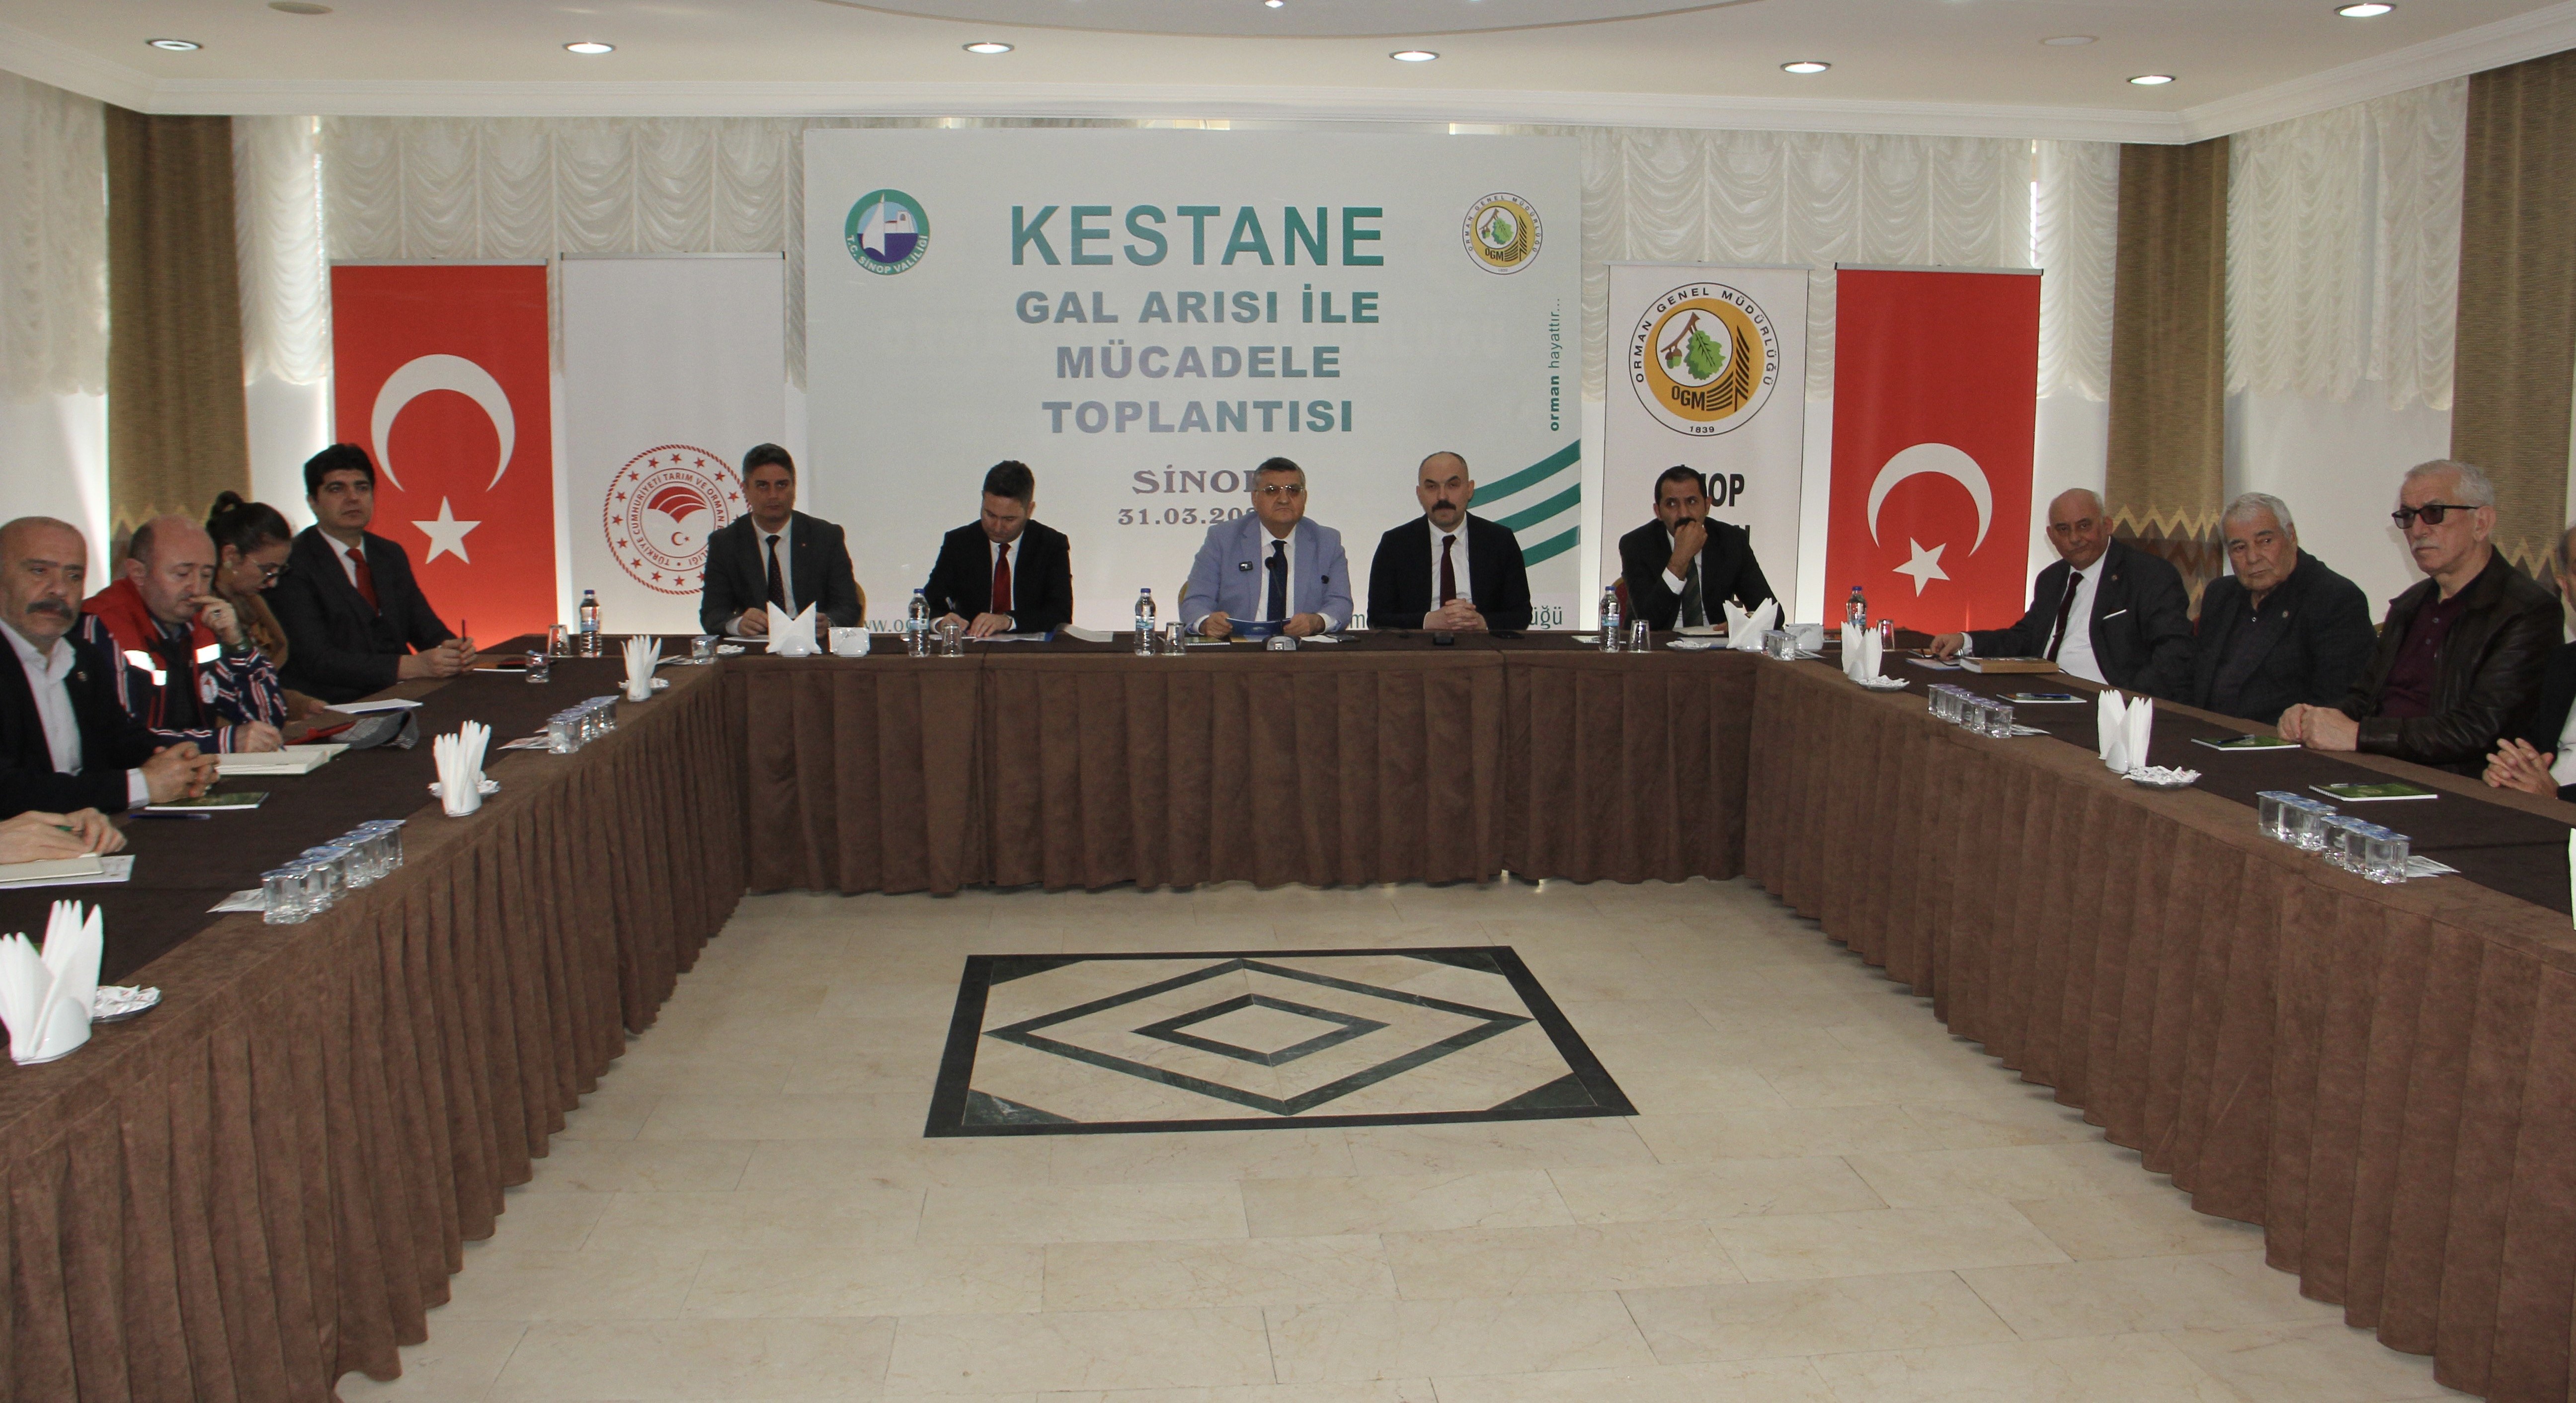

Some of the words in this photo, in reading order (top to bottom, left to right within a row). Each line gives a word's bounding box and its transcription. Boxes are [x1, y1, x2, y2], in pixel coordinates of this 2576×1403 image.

[1011, 204, 1384, 266] KESTANE
[1465, 216, 1473, 251] ORMAN
[1475, 195, 1505, 211] GENEL
[858, 256, 891, 274] SİNOP
[1484, 248, 1504, 261] OGM
[1016, 291, 1118, 324] GAL
[1139, 291, 1278, 324] ARISI
[1302, 284, 1379, 323] İLE
[1633, 320, 1652, 383] ORMAN
[1656, 287, 1709, 313] GENEL
[1722, 290, 1777, 386] MÜDÜRLÜĞÜ
[1057, 339, 1340, 379] MÜCADELE
[1550, 375, 1560, 431] orman
[1671, 386, 1705, 411] OGM
[1042, 400, 1352, 434] TOPLANTISI
[663, 472, 693, 482] TARIM
[696, 478, 707, 488] VE
[631, 475, 661, 535] CUMHURİYETİ
[707, 488, 725, 522] ORMAN
[636, 537, 670, 566] TÜRKİYE
